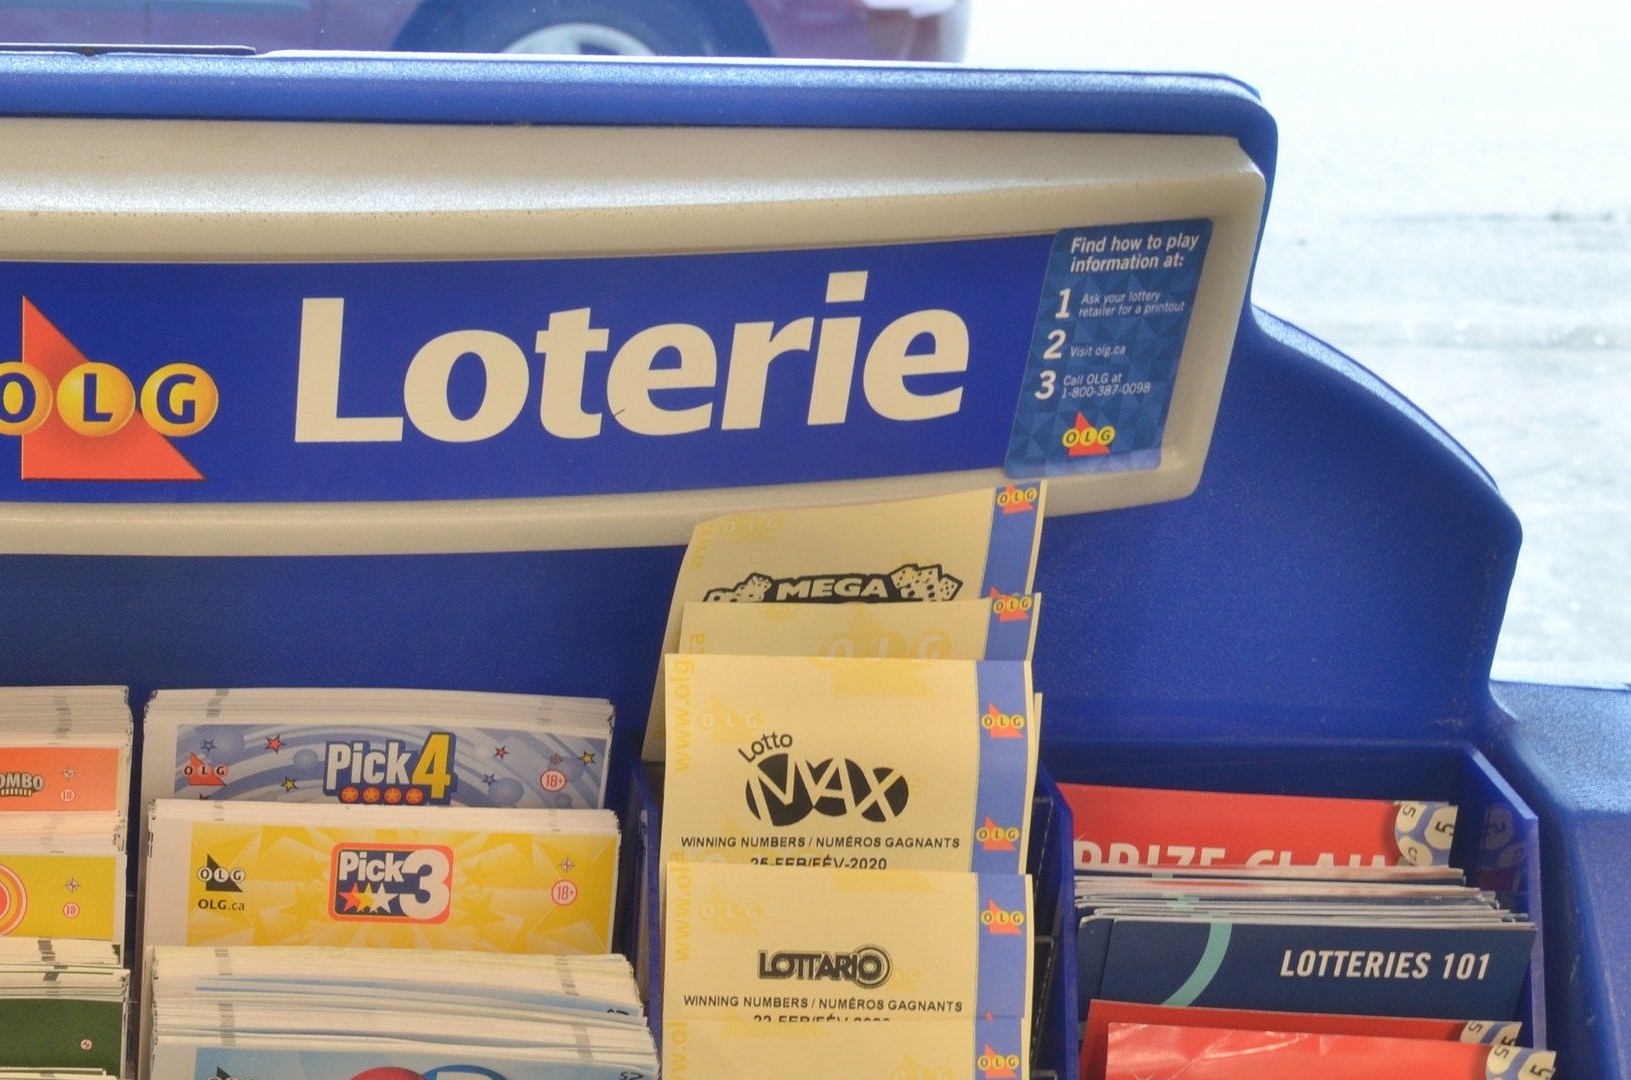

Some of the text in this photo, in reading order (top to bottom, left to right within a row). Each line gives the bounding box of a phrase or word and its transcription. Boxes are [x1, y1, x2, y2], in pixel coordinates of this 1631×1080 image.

[1071, 233, 1199, 253] Find how to play
[1071, 253, 1184, 272] information at:
[1055, 288, 1070, 319] 1
[1079, 307, 1114, 317] retailer
[1119, 306, 1131, 315] for
[1144, 302, 1185, 315] printout
[1082, 291, 1160, 307] Ask your lottery
[294, 270, 969, 443] Loterie
[1043, 330, 1066, 359] 2
[1071, 345, 1125, 358] Visit olg.ca
[1034, 370, 1056, 400] 3
[1064, 374, 1121, 386] Call OLG at
[1063, 427, 1114, 446] OLG
[776, 576, 890, 601] MEGA
[738, 732, 793, 763] Lotto
[326, 732, 452, 797] Pick 4
[745, 753, 909, 827] MAX
[198, 898, 245, 912] OLG.ca
[338, 851, 404, 882] Pick
[399, 849, 449, 919] 3
[758, 948, 892, 986] LOTTARIO
[1280, 949, 1490, 980] LOTTERIES 101
